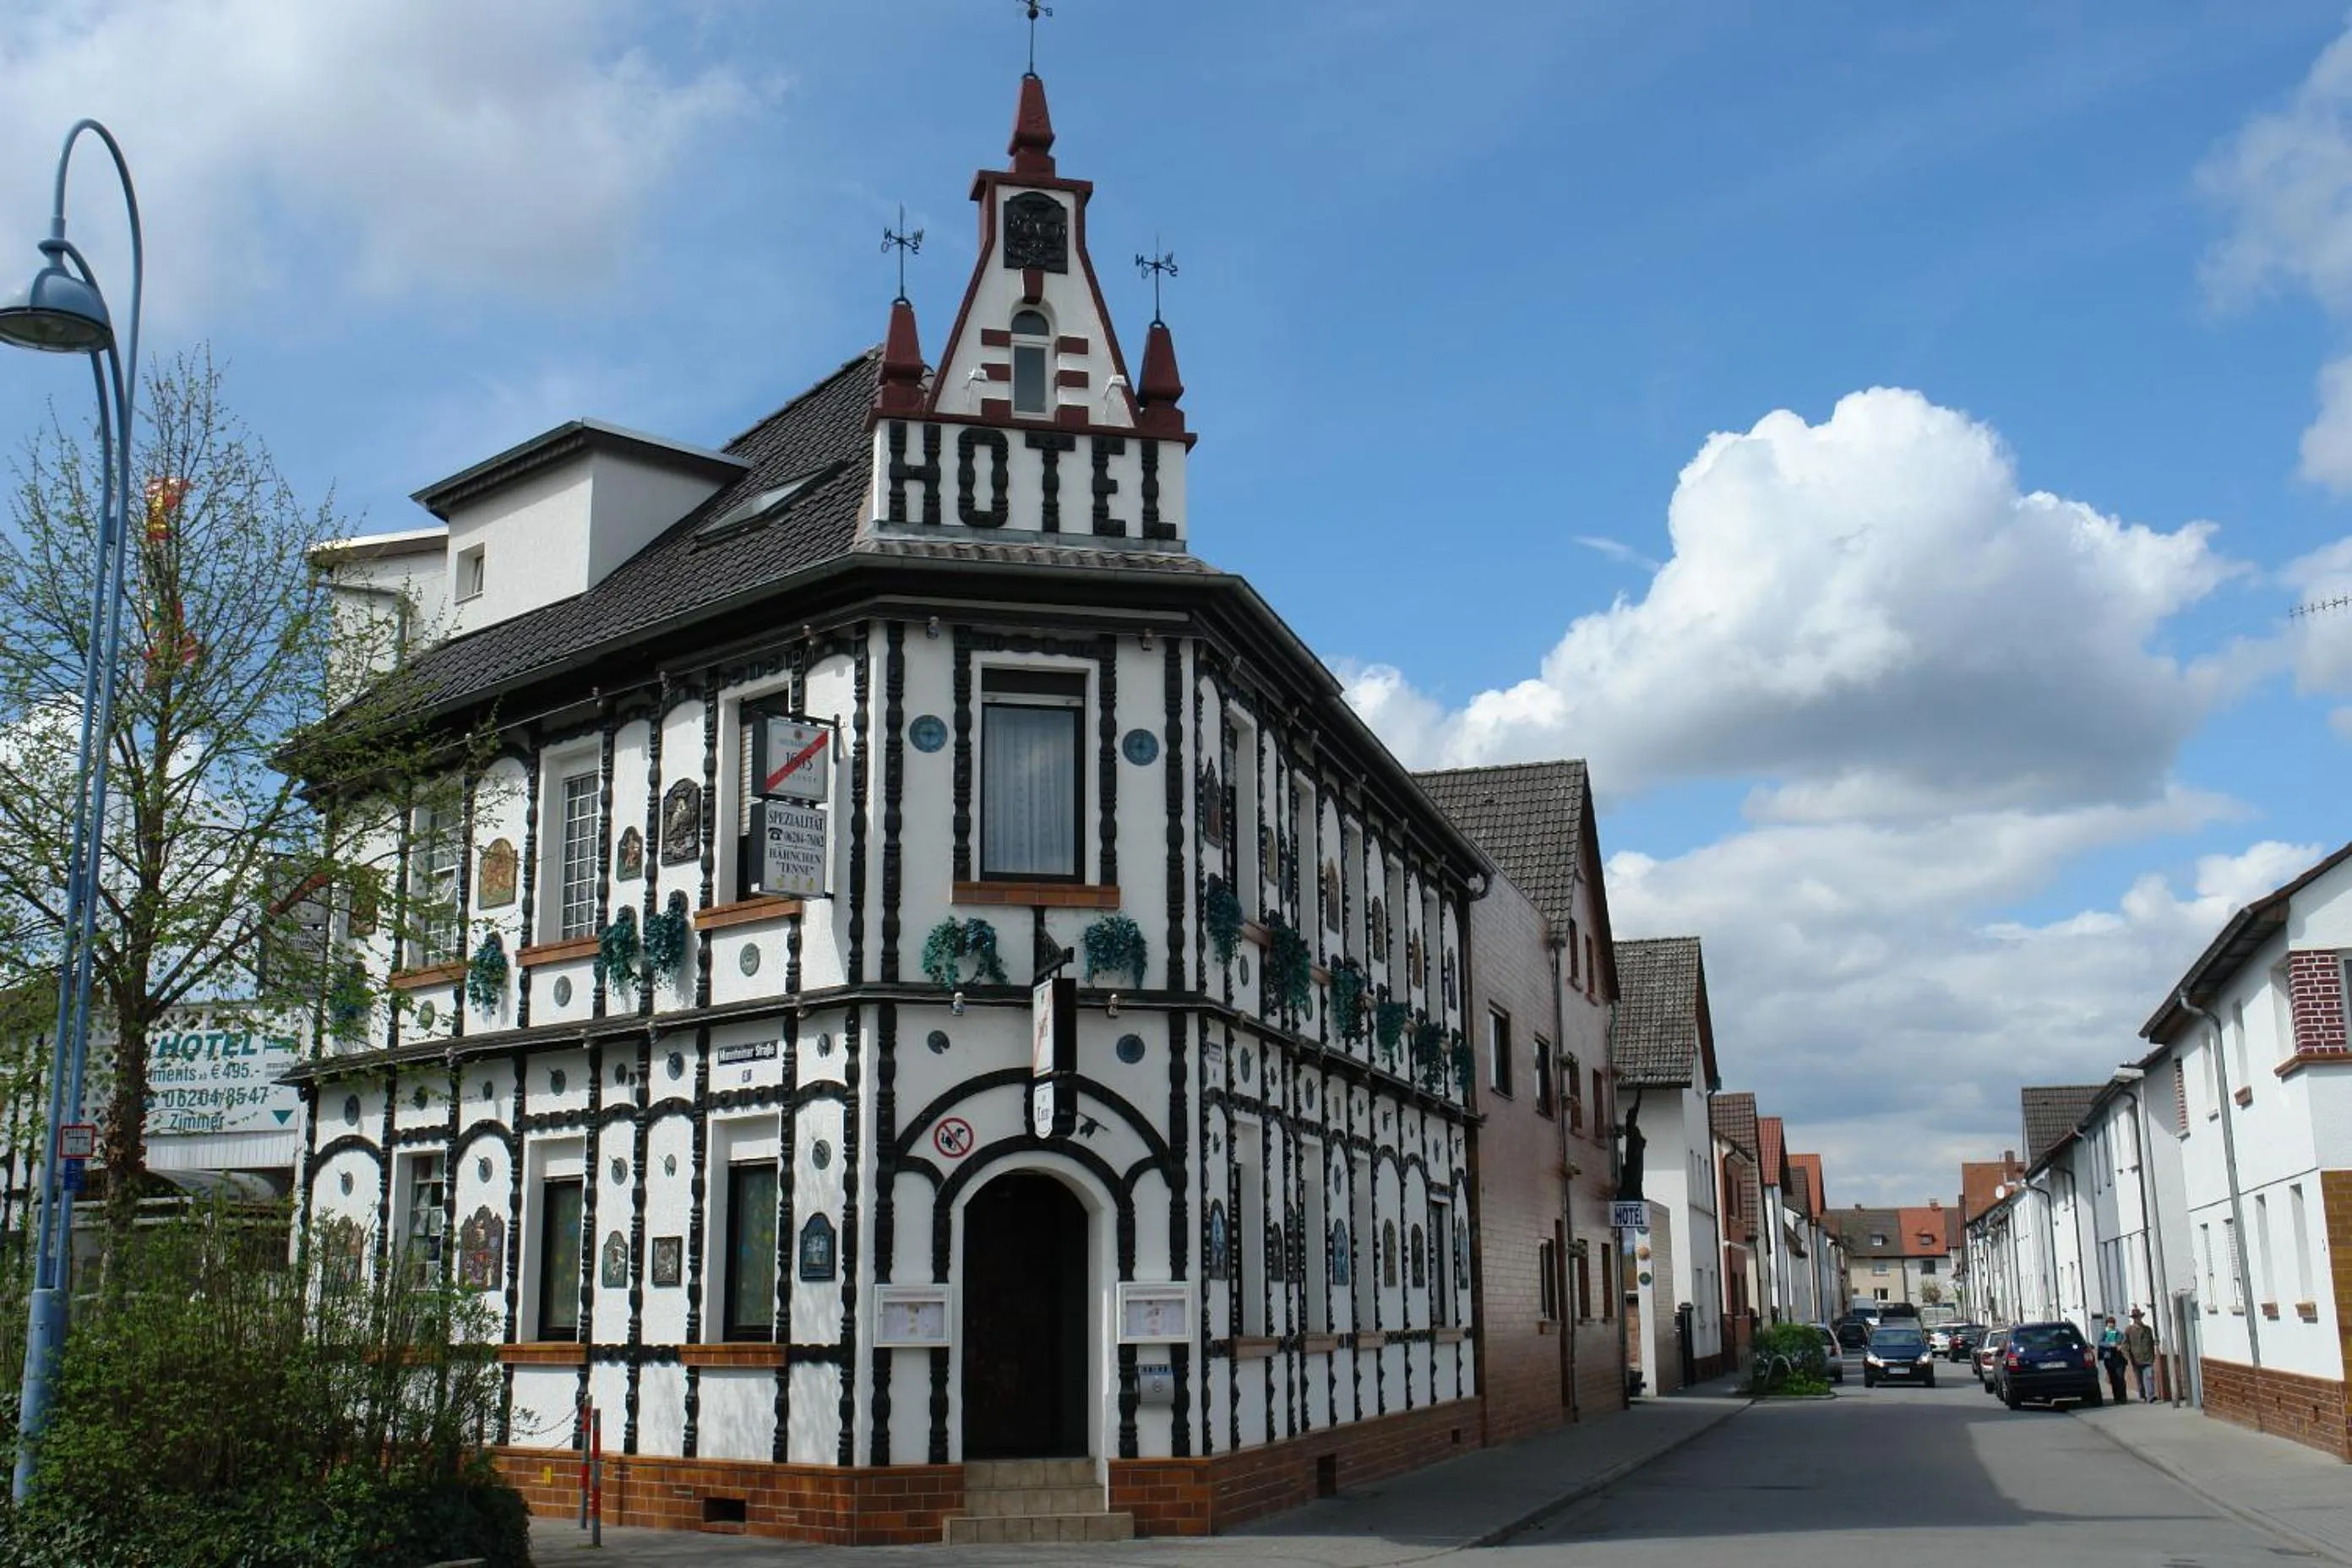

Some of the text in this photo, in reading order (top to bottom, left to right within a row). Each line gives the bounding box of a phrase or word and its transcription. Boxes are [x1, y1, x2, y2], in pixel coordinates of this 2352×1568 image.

[888, 420, 1177, 541] HOTEL
[157, 1033, 258, 1060] HOTEL
[1614, 1206, 1644, 1225] HOTEL
